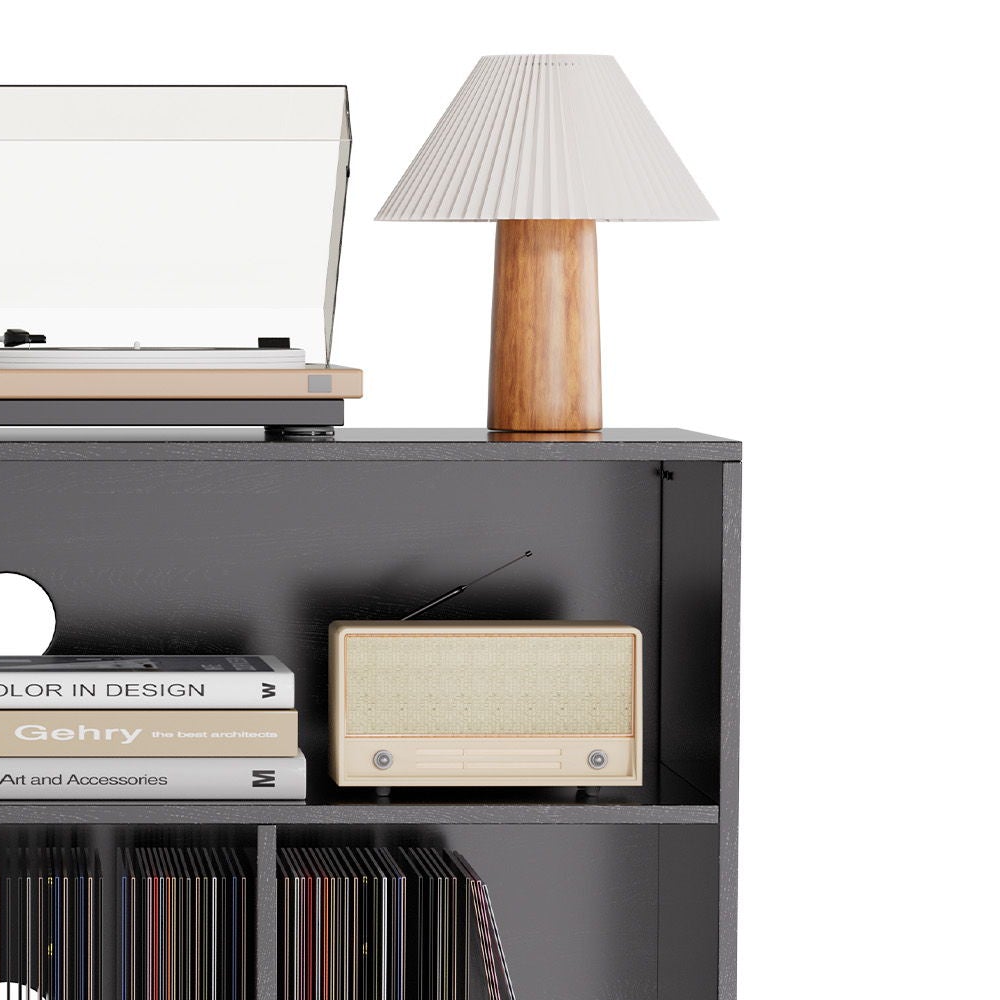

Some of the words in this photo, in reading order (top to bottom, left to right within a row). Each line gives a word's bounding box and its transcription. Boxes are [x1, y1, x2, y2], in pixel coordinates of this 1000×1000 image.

[72, 683, 96, 697] IN
[106, 683, 205, 698] DESIGN
[261, 682, 276, 699] W
[14, 724, 142, 745] Gehry
[151, 730, 174, 739] the
[177, 730, 208, 739] best
[210, 730, 279, 739] architects
[30, 773, 63, 786] and
[66, 773, 168, 786] Accessories
[251, 769, 276, 788] M
